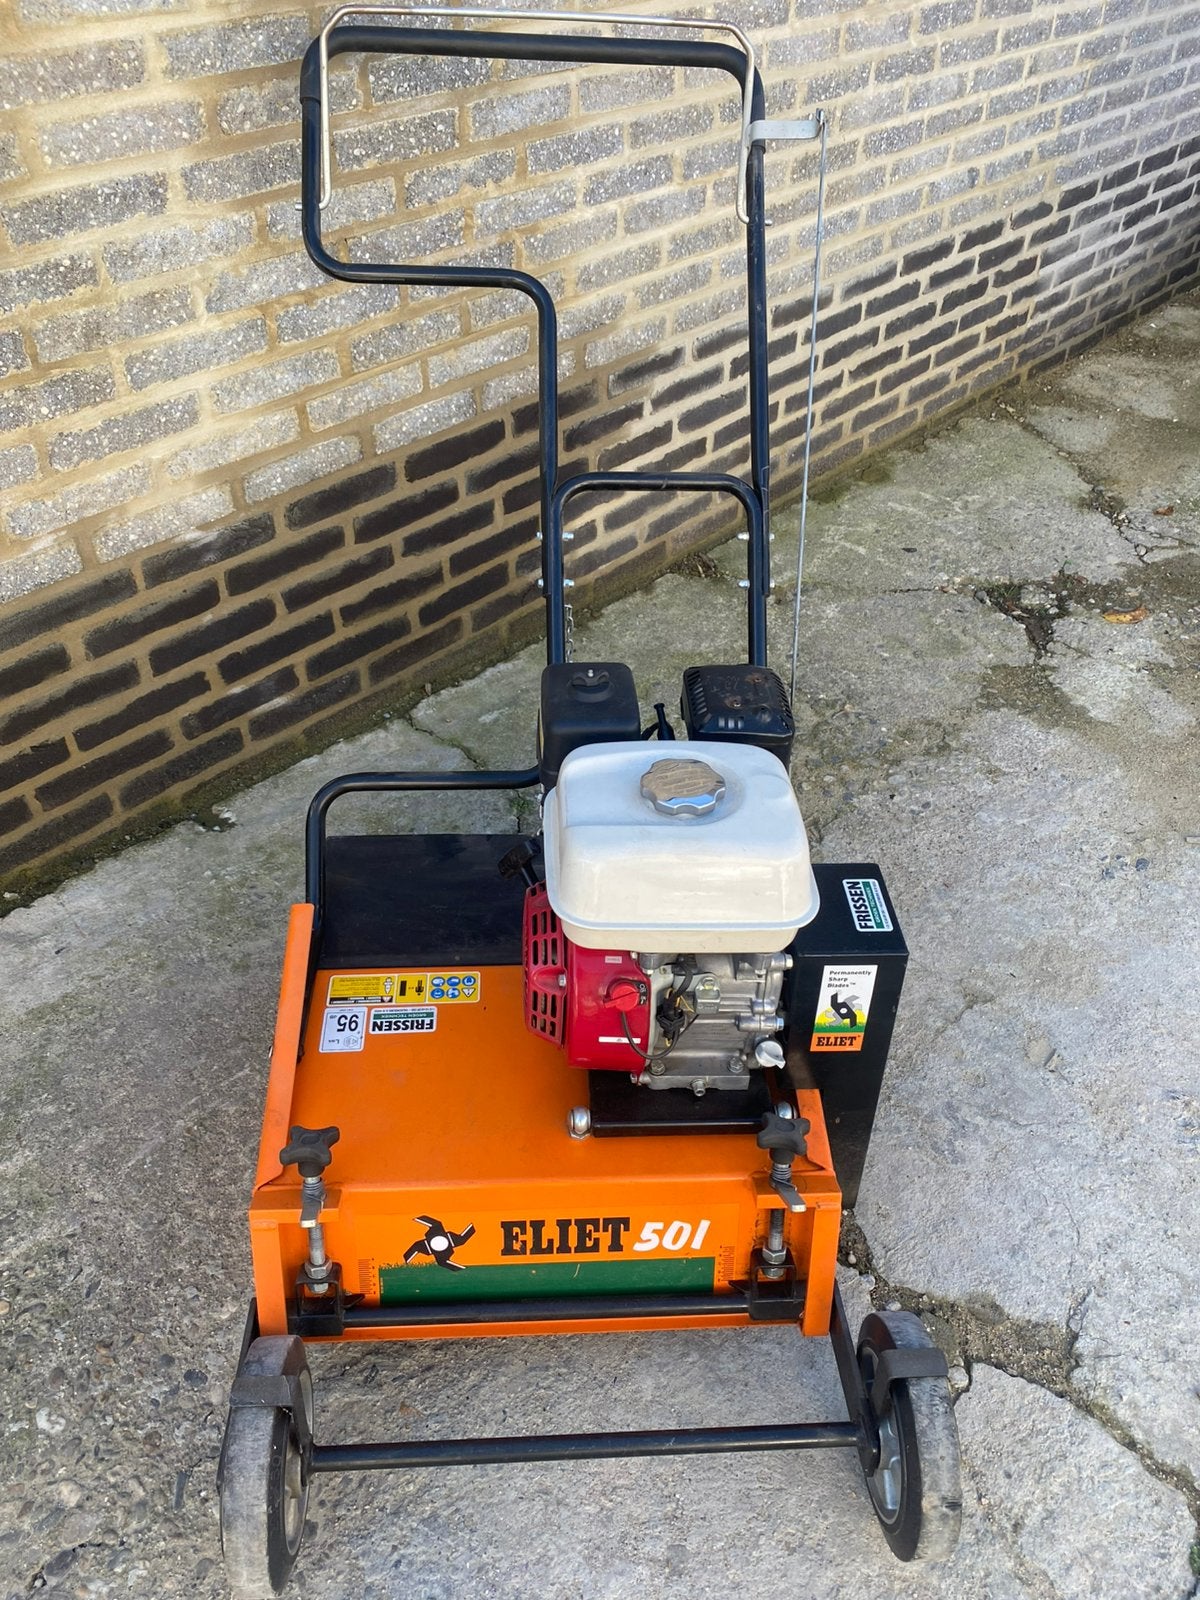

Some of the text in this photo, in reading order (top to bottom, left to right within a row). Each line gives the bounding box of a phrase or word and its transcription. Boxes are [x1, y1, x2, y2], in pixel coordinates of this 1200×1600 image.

[846, 881, 874, 929] FRISSEN
[337, 1014, 360, 1032] 95
[371, 1018, 434, 1032] FRISSEN
[816, 1036, 857, 1047] ELIET
[500, 1217, 631, 1256] ELIET
